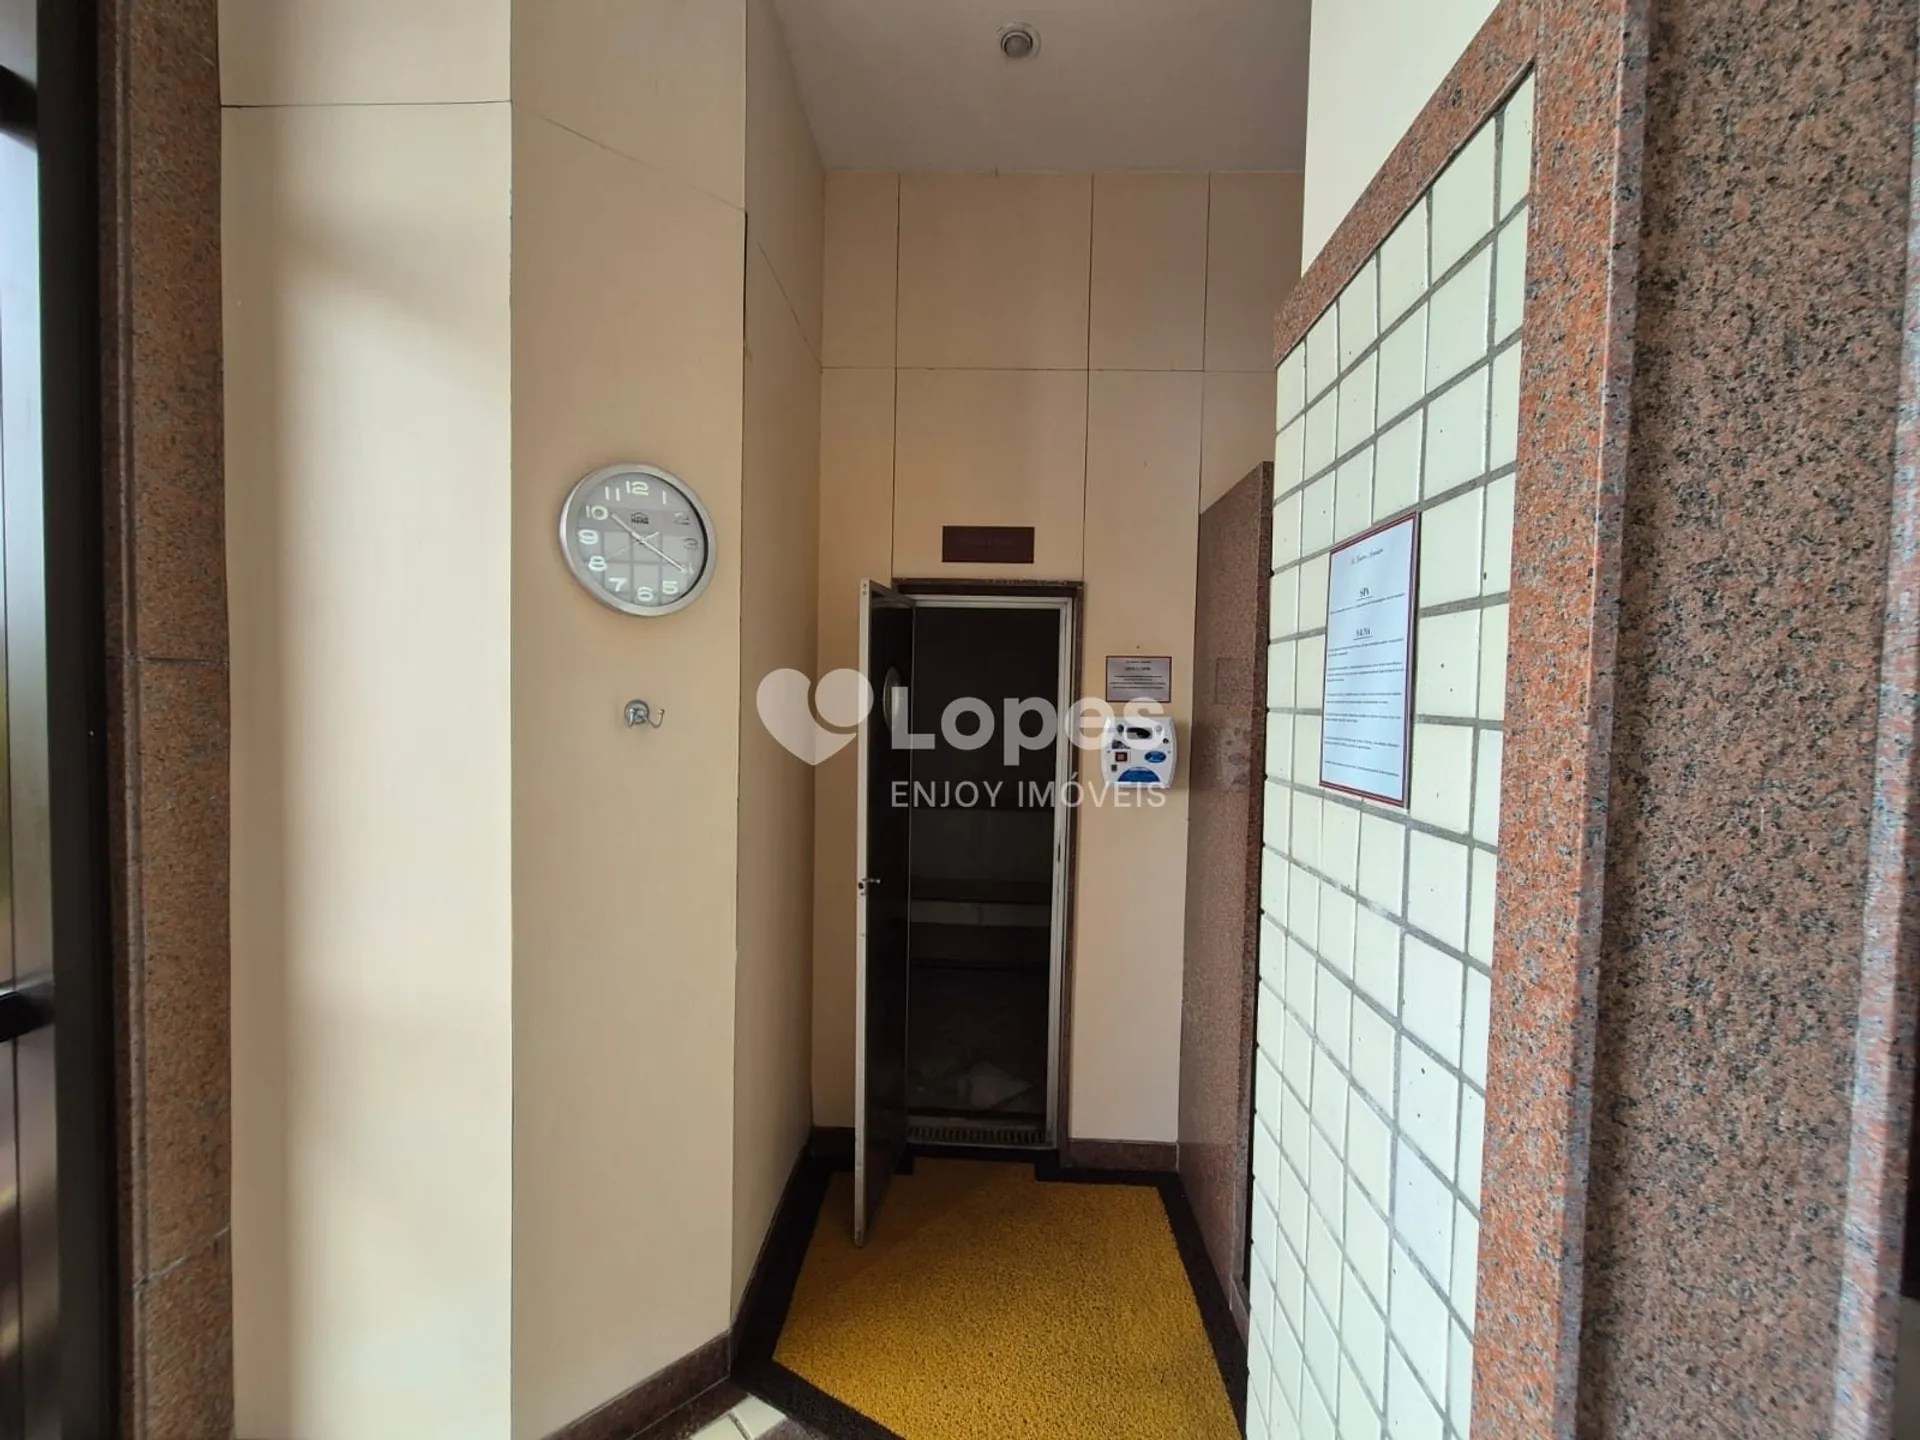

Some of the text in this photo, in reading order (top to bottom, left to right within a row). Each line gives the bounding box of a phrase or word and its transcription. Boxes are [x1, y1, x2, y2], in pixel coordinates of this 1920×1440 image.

[605, 487, 620, 501] 11
[626, 481, 649, 496] 12
[662, 491, 667, 505] 1
[586, 505, 608, 520] 10
[674, 512, 691, 525] 2
[578, 529, 598, 545] 9
[683, 537, 699, 550] 3
[588, 556, 608, 571] 8
[609, 578, 627, 592] 7
[662, 580, 679, 594] 5
[637, 586, 654, 602] 6
